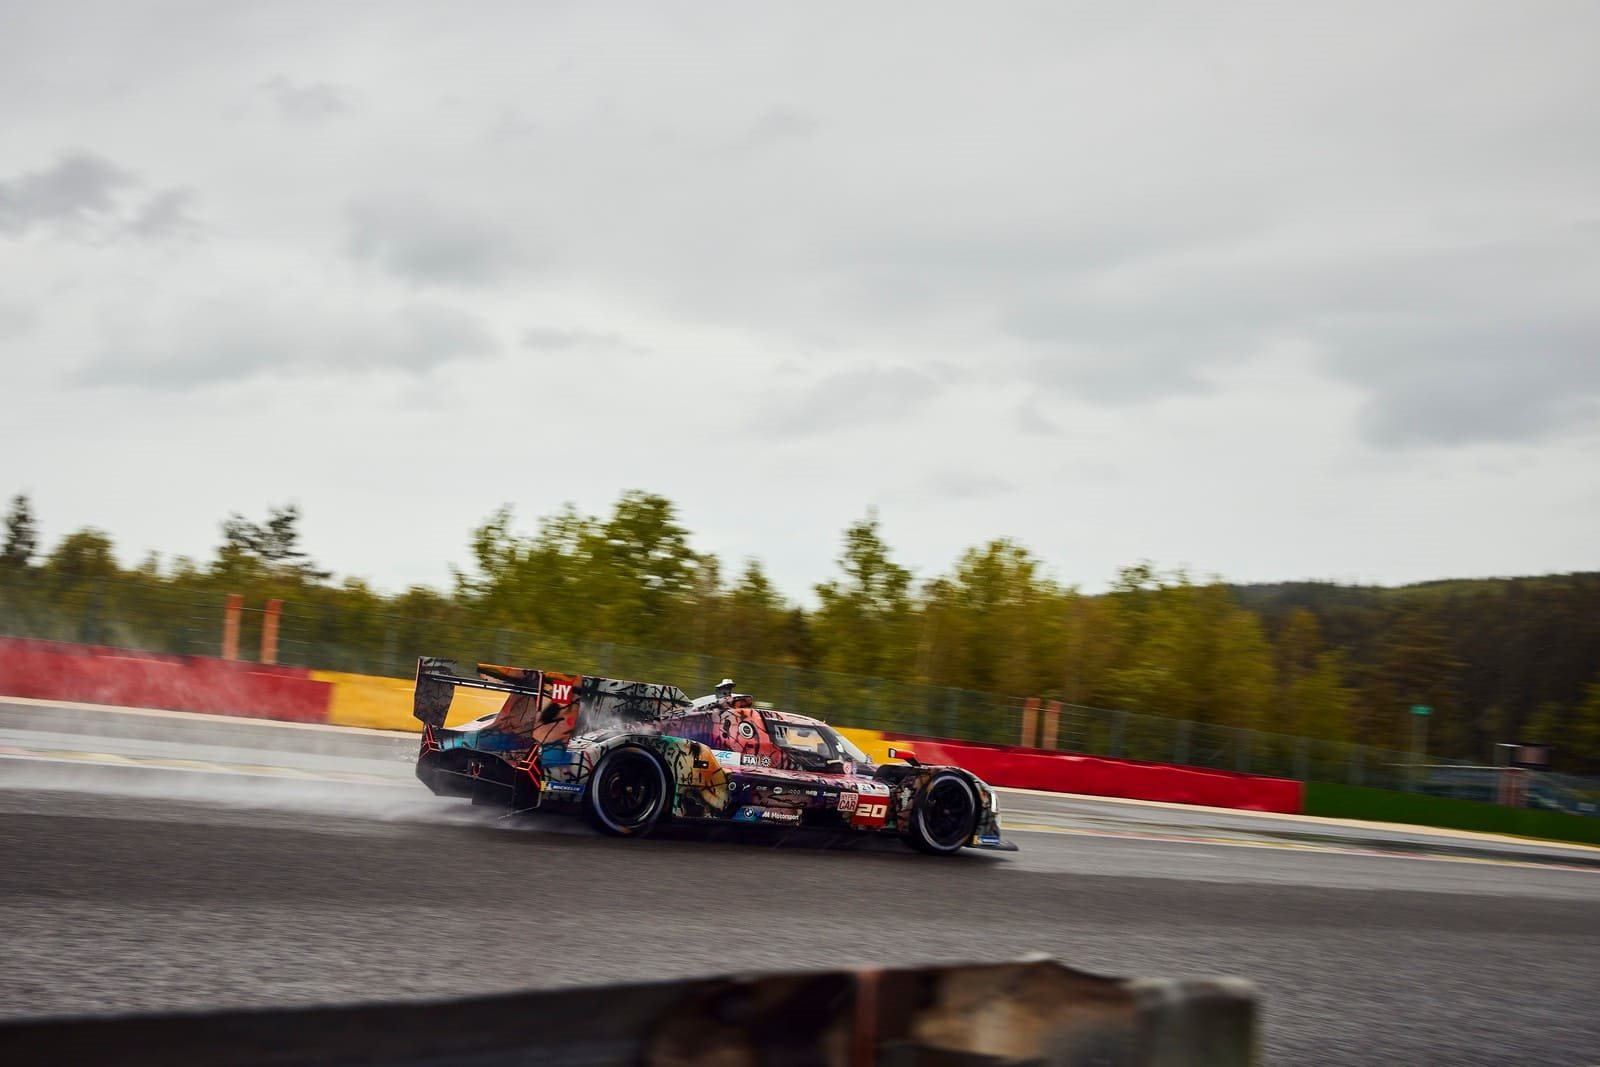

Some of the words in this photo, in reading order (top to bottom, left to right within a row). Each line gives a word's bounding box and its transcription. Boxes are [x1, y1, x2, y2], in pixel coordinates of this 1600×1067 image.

[552, 684, 572, 700] HY
[743, 755, 757, 765] FIA
[552, 784, 581, 792] MICHELIN
[839, 800, 856, 810] CAR
[771, 811, 799, 821] Motorsport
[856, 803, 888, 819] 20
